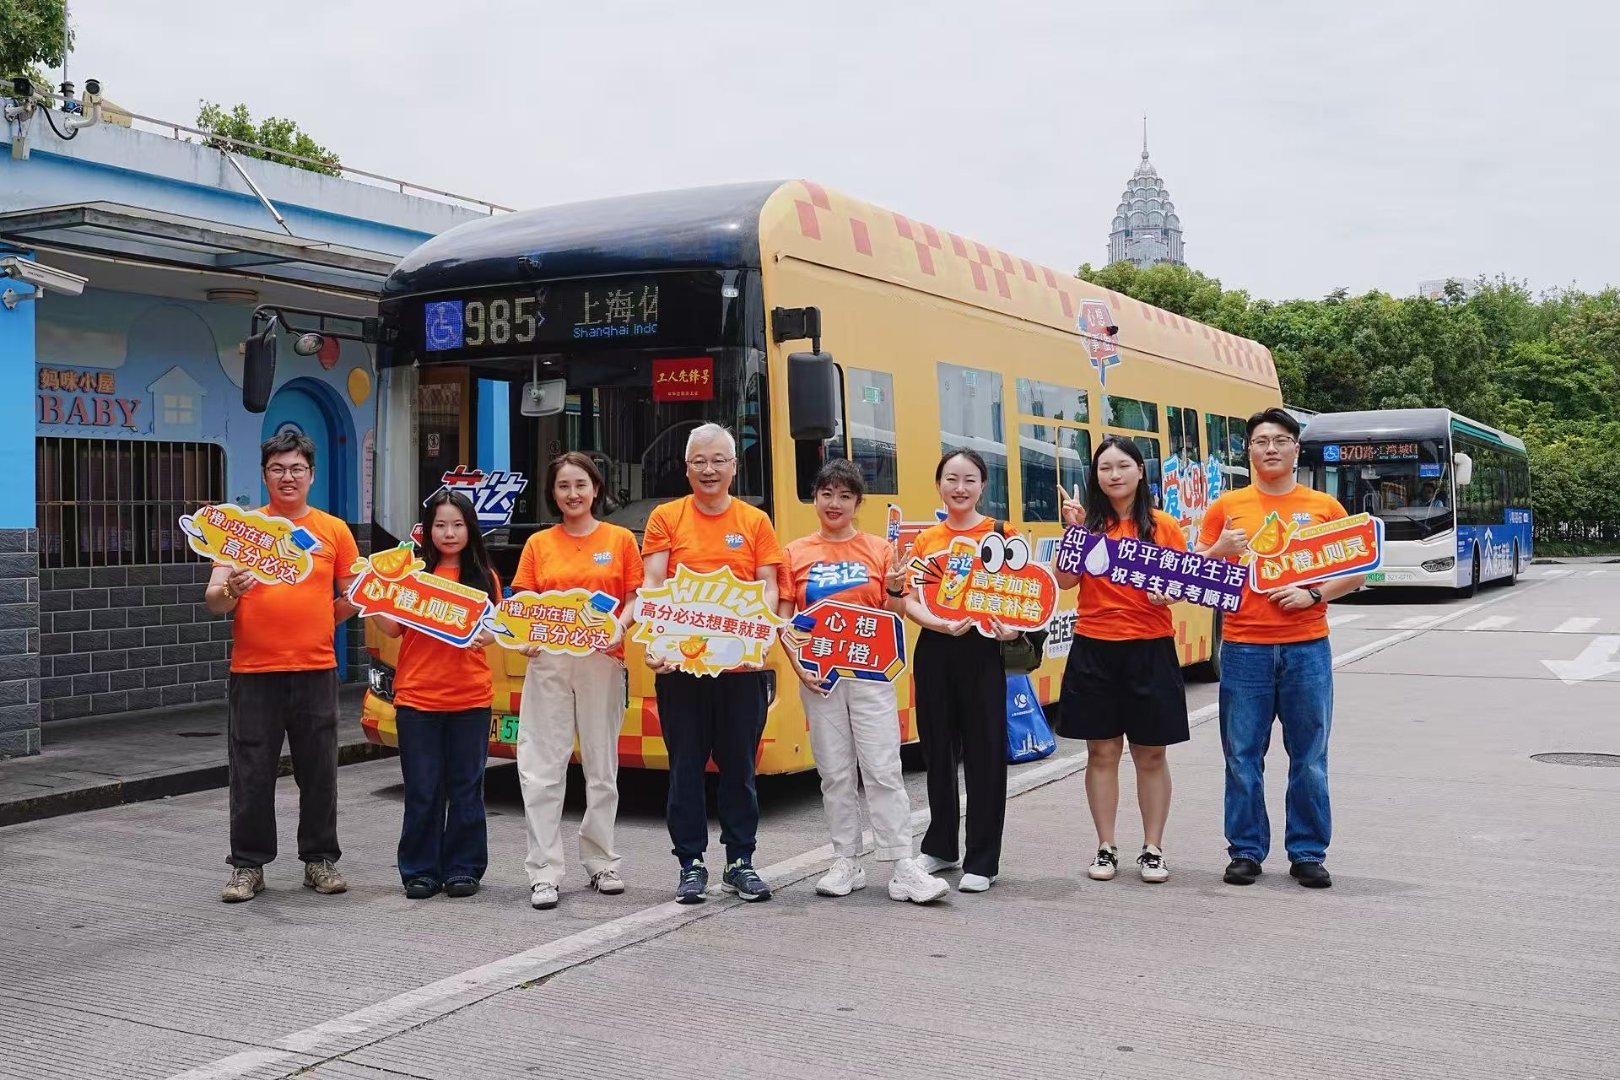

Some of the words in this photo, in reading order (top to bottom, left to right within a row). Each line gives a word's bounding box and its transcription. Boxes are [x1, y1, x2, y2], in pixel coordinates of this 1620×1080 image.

[464, 297, 537, 346] 985
[573, 324, 629, 338] Shanghai
[39, 367, 115, 394] 妈咪小屋
[657, 369, 710, 385] 工人先锋号
[38, 394, 141, 428] BABY
[1163, 455, 1221, 519] 爱心助考
[202, 505, 275, 551] 「橙」功在握
[221, 537, 300, 585] 高分必达
[811, 562, 869, 588] 芬达
[1118, 539, 1246, 587] 悦平衡悦生活
[1261, 535, 1369, 579] 心「橙」则灵
[971, 570, 1042, 599] 高考加油
[1111, 566, 1240, 611] 祝考生高考顺利
[362, 578, 469, 630] 心「橙」则灵
[500, 600, 577, 624] 「橙」功在握
[640, 601, 772, 641] 高分必达想要就要
[966, 589, 1043, 622] 橙意补给
[529, 623, 611, 650] 高分必达
